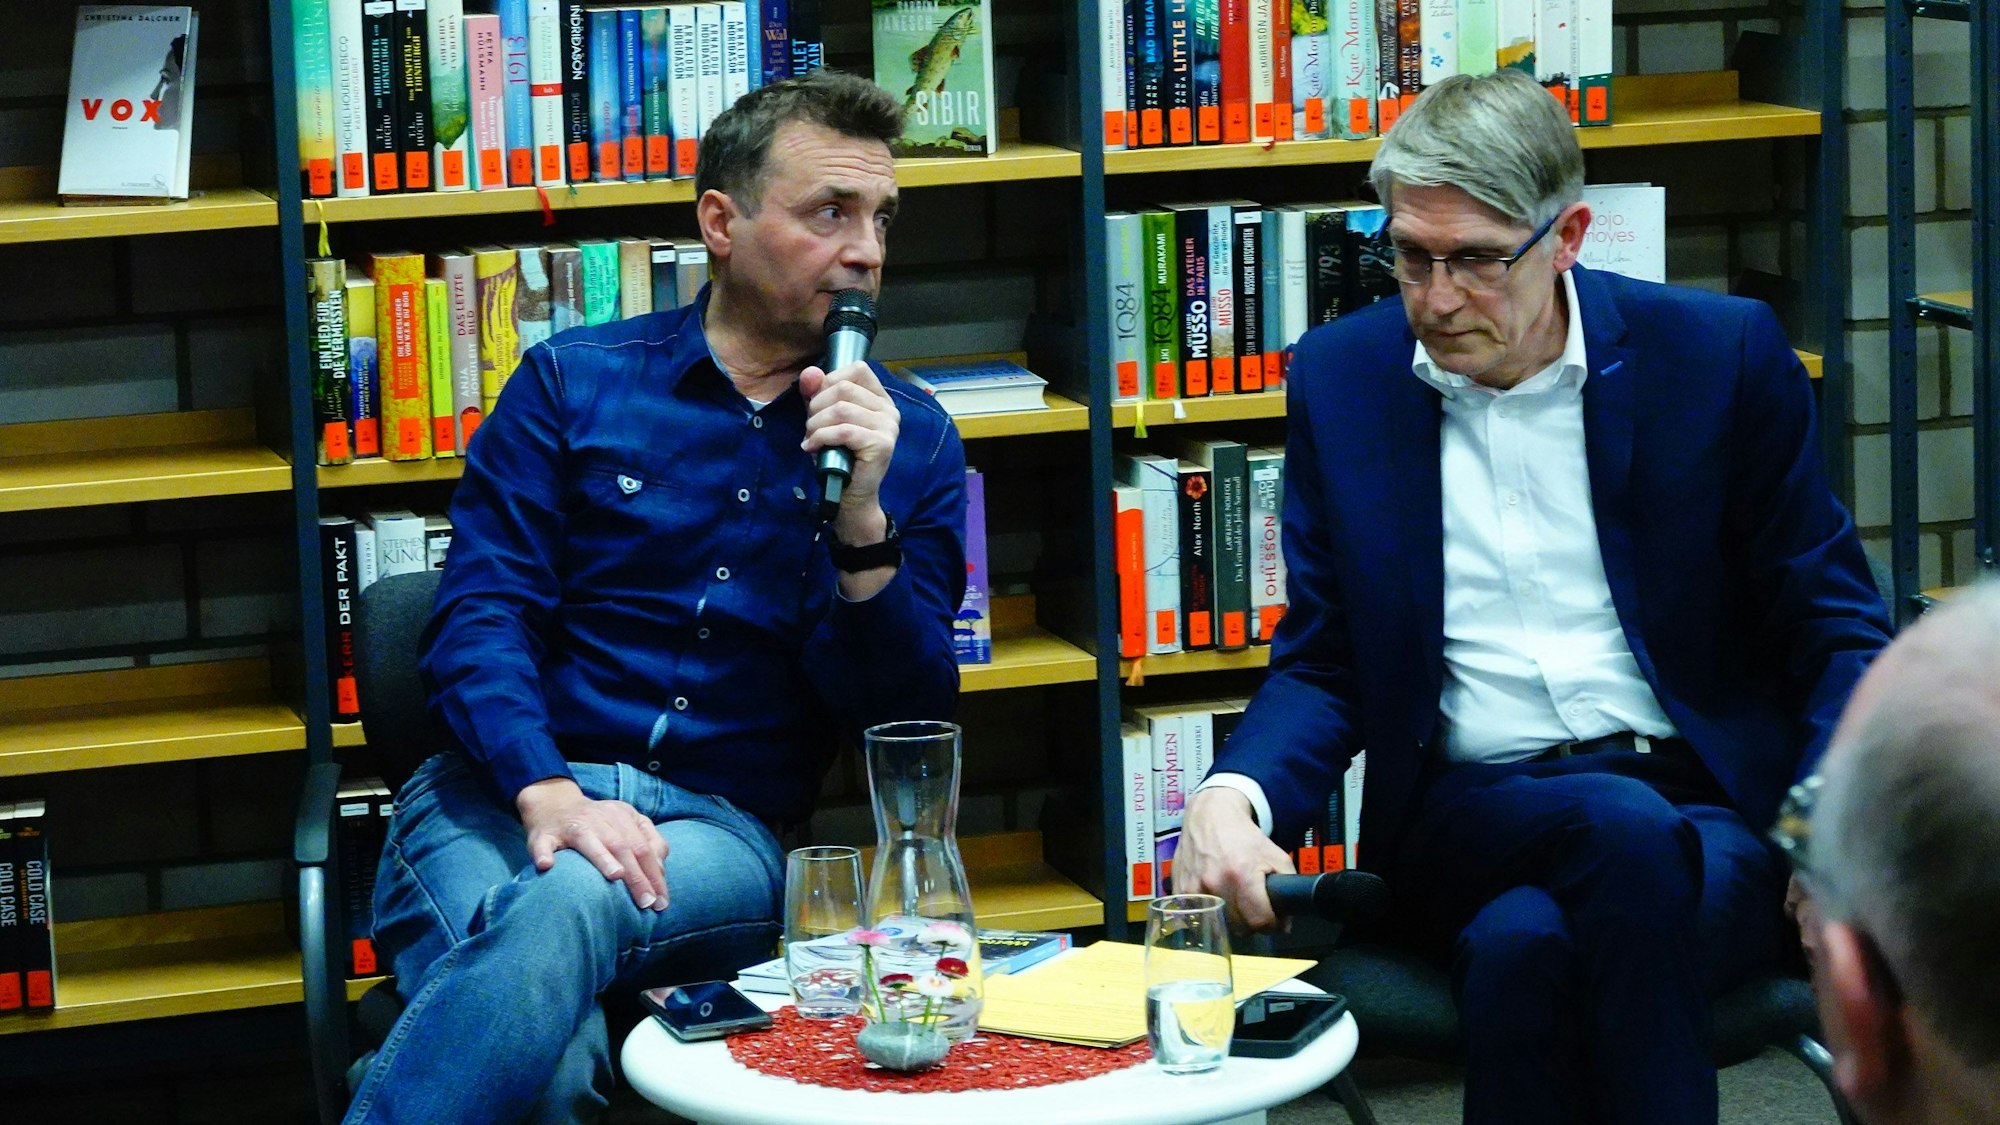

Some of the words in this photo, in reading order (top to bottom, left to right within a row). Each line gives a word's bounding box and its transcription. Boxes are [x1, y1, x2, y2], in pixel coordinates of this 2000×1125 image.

[765, 28, 788, 41] Wal
[1195, 17, 1206, 36] DER
[1211, 15, 1219, 40] TIGER
[1340, 0, 1359, 57] Morto
[508, 36, 528, 82] 1913
[684, 25, 694, 79] ARNALDUR
[710, 23, 719, 76] ARNALDUR
[736, 21, 746, 73] ARNALDUR
[1145, 39, 1156, 63] BAD
[1172, 20, 1187, 72] LITTLE
[1257, 20, 1268, 68] MORRISON
[339, 35, 350, 111] HOUELLEBECQ
[1345, 54, 1365, 86] Kate
[1402, 47, 1410, 86] MARTIN
[1411, 40, 1419, 92] MOSEBACH
[81, 98, 163, 122] VOX
[915, 90, 980, 126] SIBIR
[1199, 90, 1209, 107] difa
[342, 116, 352, 151] MICHEL
[1583, 229, 1635, 248] moyes
[588, 256, 597, 289] Jonasson
[1157, 233, 1168, 284] MURAKAMI
[1185, 237, 1195, 275] ATELIER
[1197, 256, 1205, 283] PARIS
[454, 273, 464, 310] LETZTE
[1186, 277, 1195, 297] DAS
[1197, 286, 1205, 296] IN
[1244, 265, 1256, 295] RUSSISCHE
[590, 293, 598, 312] Jonas
[1115, 281, 1140, 340] 1Q84
[1151, 288, 1176, 343] 1Q84
[1218, 288, 1232, 327] MUSSO
[318, 325, 331, 348] LIED
[329, 290, 344, 359] VERMISSTEN
[395, 298, 403, 344] LIEBESLIEDER
[457, 314, 466, 336] DAS
[467, 310, 476, 334] BILD
[1190, 300, 1208, 358] MUSSO
[319, 351, 332, 369] EIN
[495, 333, 503, 366] Jonasson
[1161, 348, 1169, 363] UKI
[332, 360, 346, 378] DIE
[459, 367, 469, 397] ANJA
[468, 343, 480, 397] JONULEIT
[1258, 480, 1267, 496] TO
[1192, 501, 1202, 531] North
[1225, 513, 1233, 551] LAWRENCE
[382, 537, 425, 549] STEPHEN
[383, 547, 425, 564] KING
[1194, 533, 1202, 557] Alex
[1264, 516, 1277, 597] OHLSSON
[334, 537, 349, 583] PAKT
[1235, 568, 1243, 582] Das
[338, 587, 351, 625] DER
[1165, 733, 1179, 817] STIMMEN
[0, 862, 15, 894] COLD
[26, 860, 44, 893] COLD
[1, 896, 17, 927] CASE
[29, 894, 46, 925] CASE
